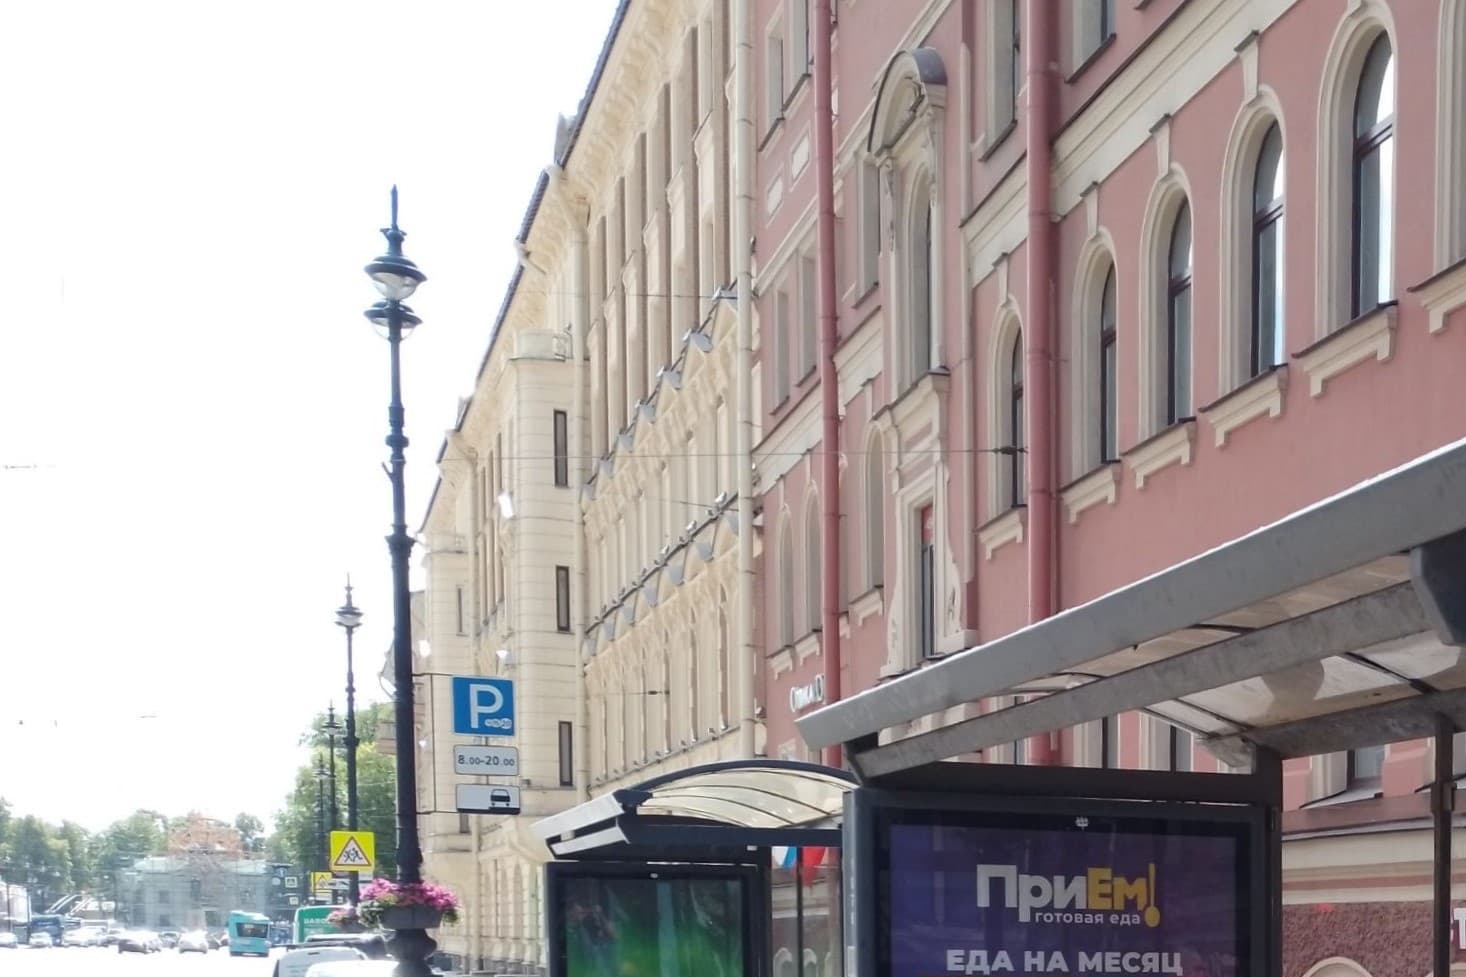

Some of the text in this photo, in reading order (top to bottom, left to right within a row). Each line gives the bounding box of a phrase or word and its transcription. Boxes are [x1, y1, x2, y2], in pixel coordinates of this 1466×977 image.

[458, 754, 515, 767] 8.00-20.00
[1035, 911, 1141, 926] готовая еда
[946, 949, 1183, 976] ЕДА НА МЕСЯЦ
